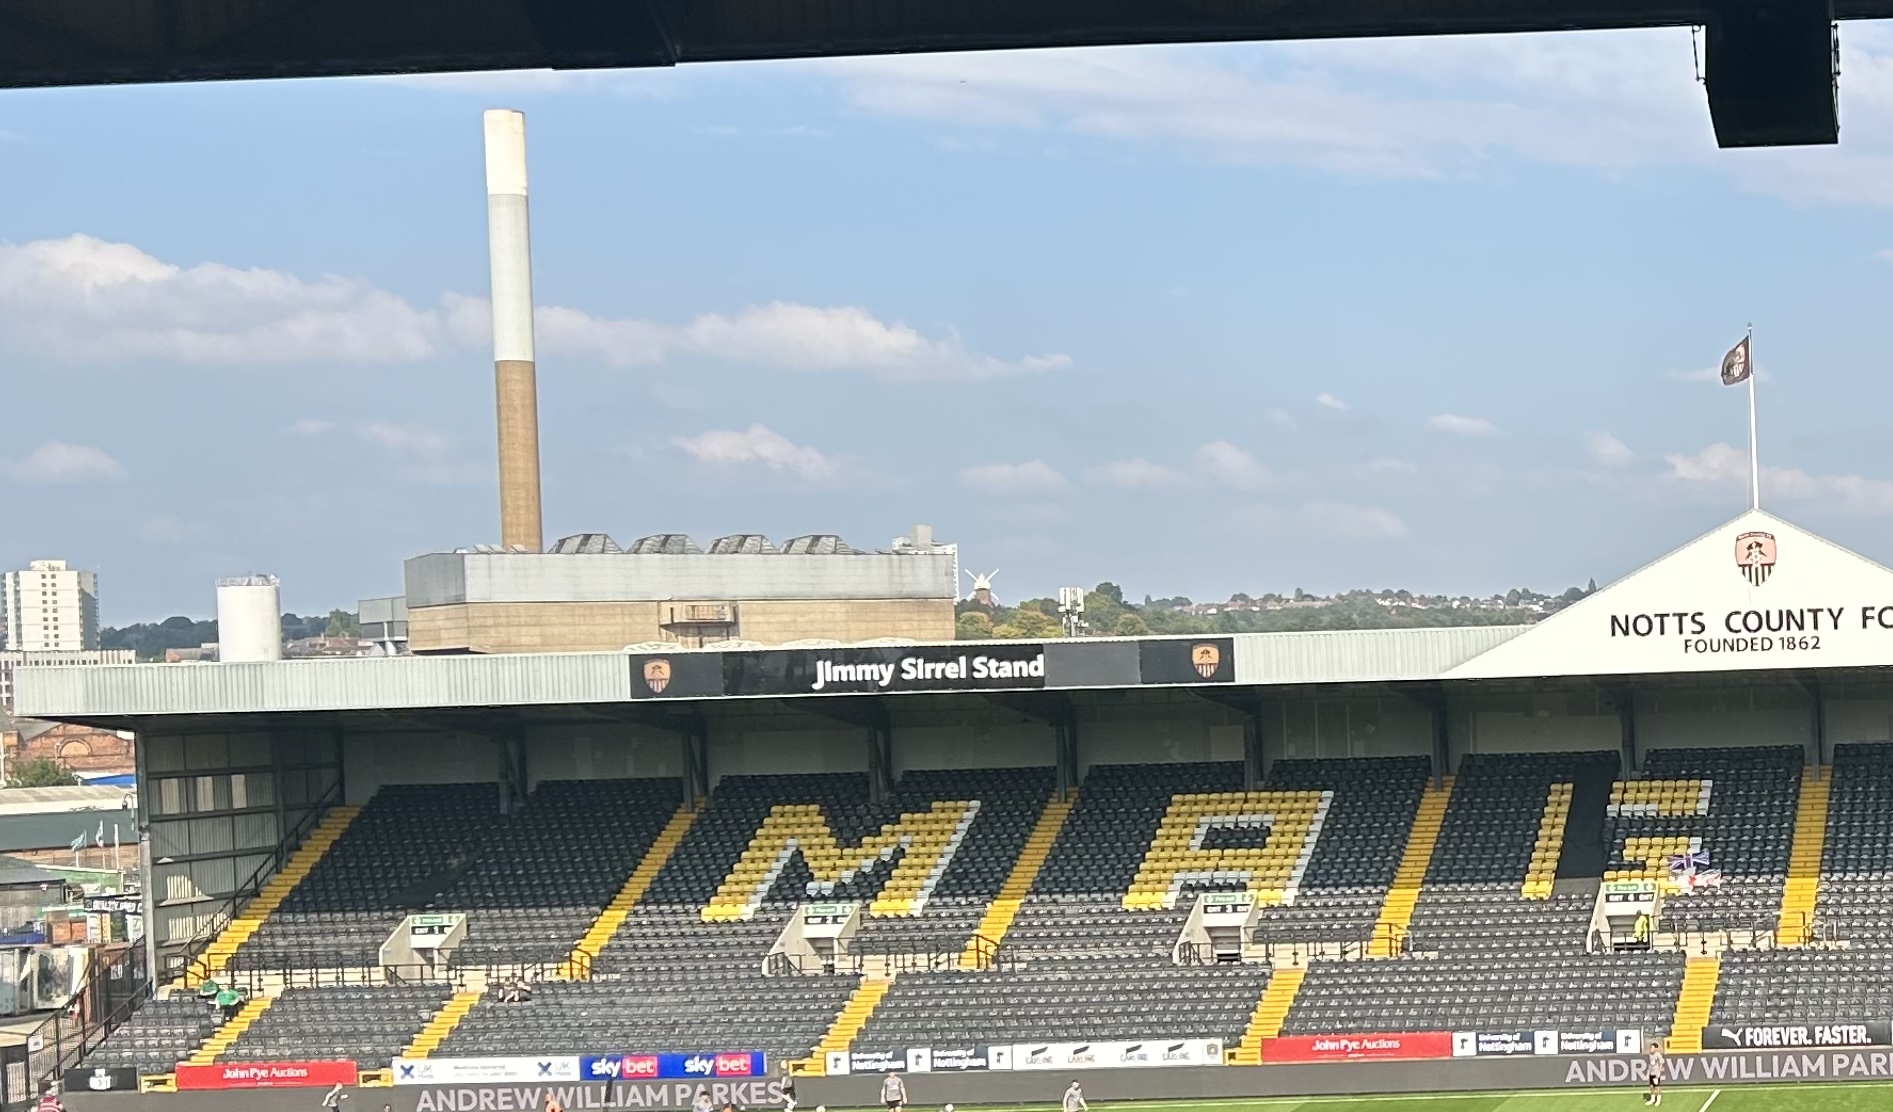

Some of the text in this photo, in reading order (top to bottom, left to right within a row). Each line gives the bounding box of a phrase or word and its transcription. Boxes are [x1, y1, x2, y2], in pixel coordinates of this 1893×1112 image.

[1610, 612, 1706, 637] NOTTS
[1724, 606, 1845, 634] COUNTY
[1684, 635, 1822, 654] FOUNDED 1862
[811, 653, 1046, 690] Jimmy Sirrel Stand
[1312, 1038, 1401, 1053] John Pye Auctions
[1744, 1025, 1872, 1047] FOREVER. FASTER.
[223, 1067, 309, 1081] John Pye Auctions
[417, 1064, 433, 1073] UK
[554, 1062, 570, 1070] UK
[590, 1057, 655, 1079] sky bet
[683, 1056, 749, 1077] sky bet
[1564, 1056, 1695, 1084] ANDRW
[1701, 1054, 1826, 1081] WILLIAM
[546, 1084, 670, 1110] WILLIAM
[675, 1081, 783, 1107] PARKES
